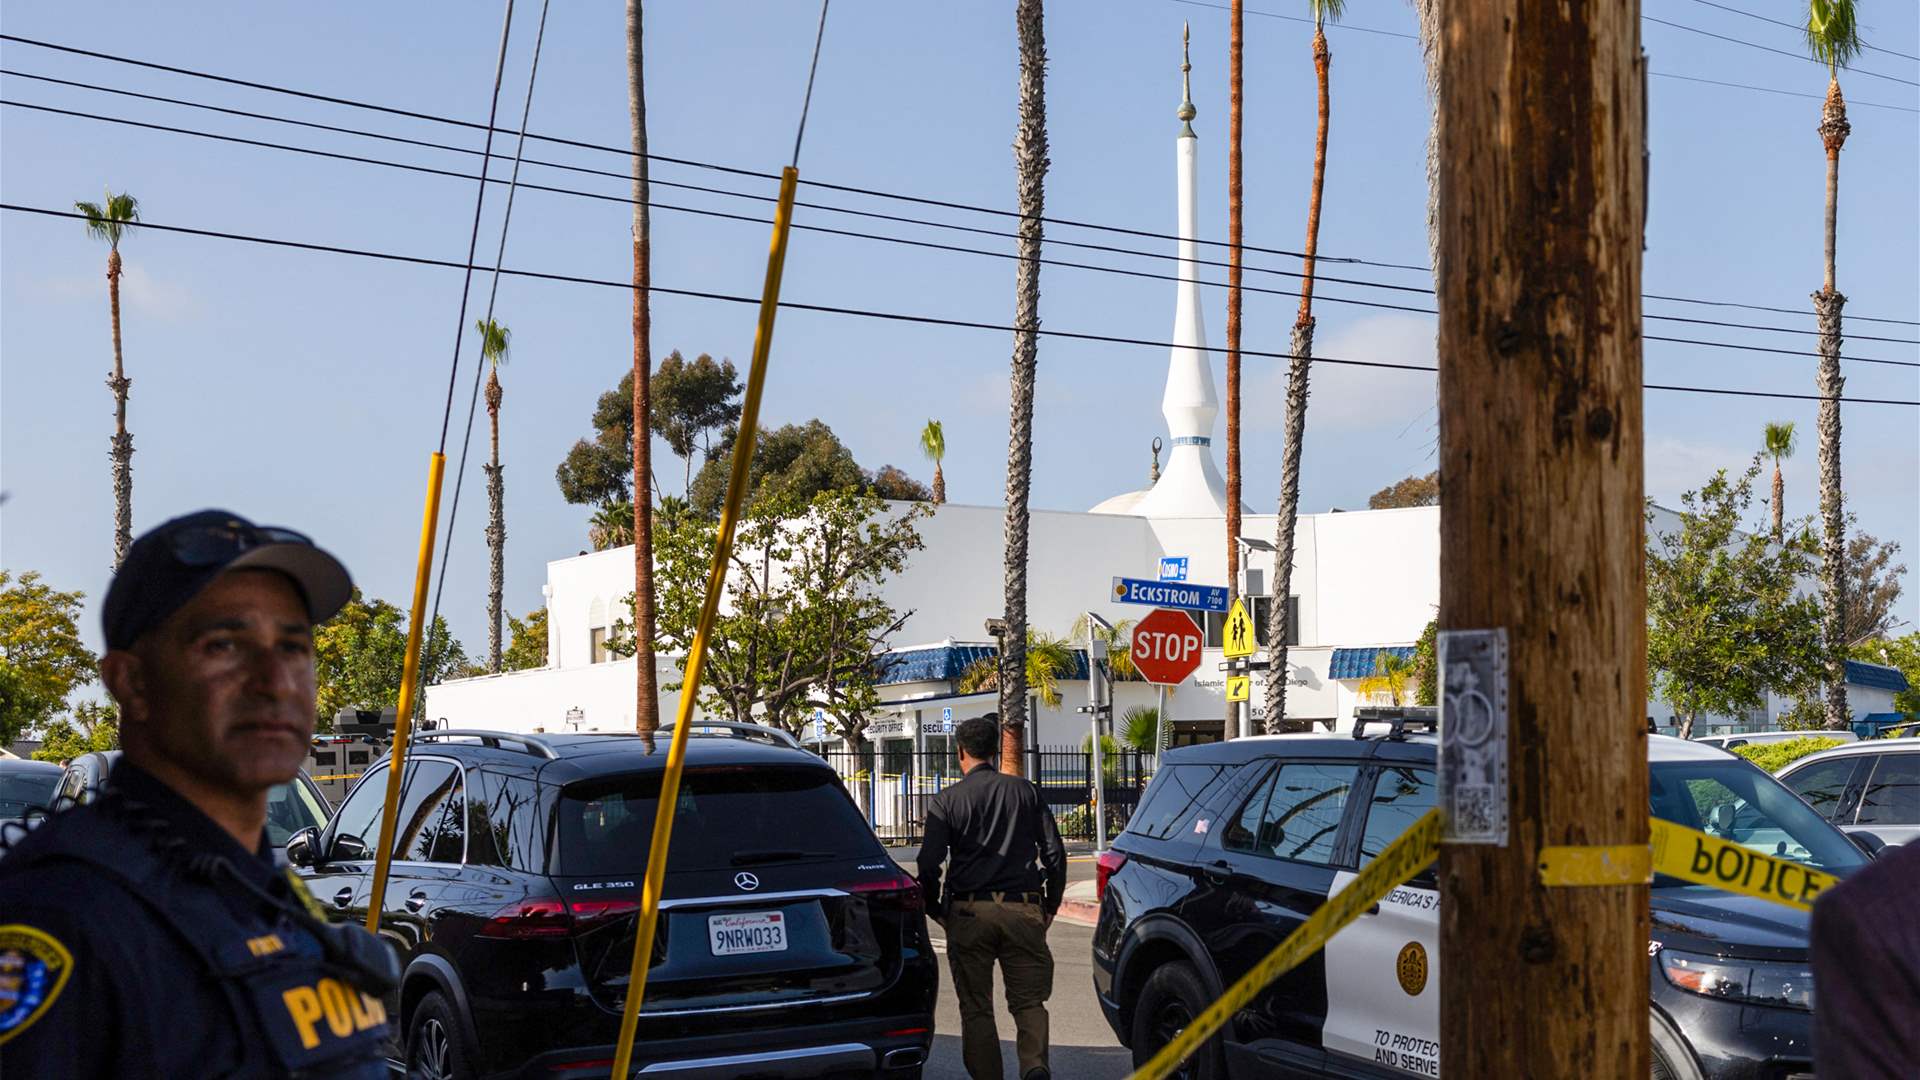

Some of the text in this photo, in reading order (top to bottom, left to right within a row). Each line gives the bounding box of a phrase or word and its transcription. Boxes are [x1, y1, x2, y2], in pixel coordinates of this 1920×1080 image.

[1130, 583, 1200, 605] ECKSTROM
[1207, 596, 1223, 605] 7100
[1210, 588, 1220, 596] AV
[1135, 631, 1199, 662] STOP
[1194, 679, 1225, 688] Islamic
[1255, 679, 1264, 687] of
[888, 722, 904, 733] OFFICE
[724, 916, 769, 928] California
[716, 926, 782, 950] 9NRW033
[1374, 1029, 1439, 1057] TO PROTEC
[1375, 1047, 1438, 1076] AND SERVE
